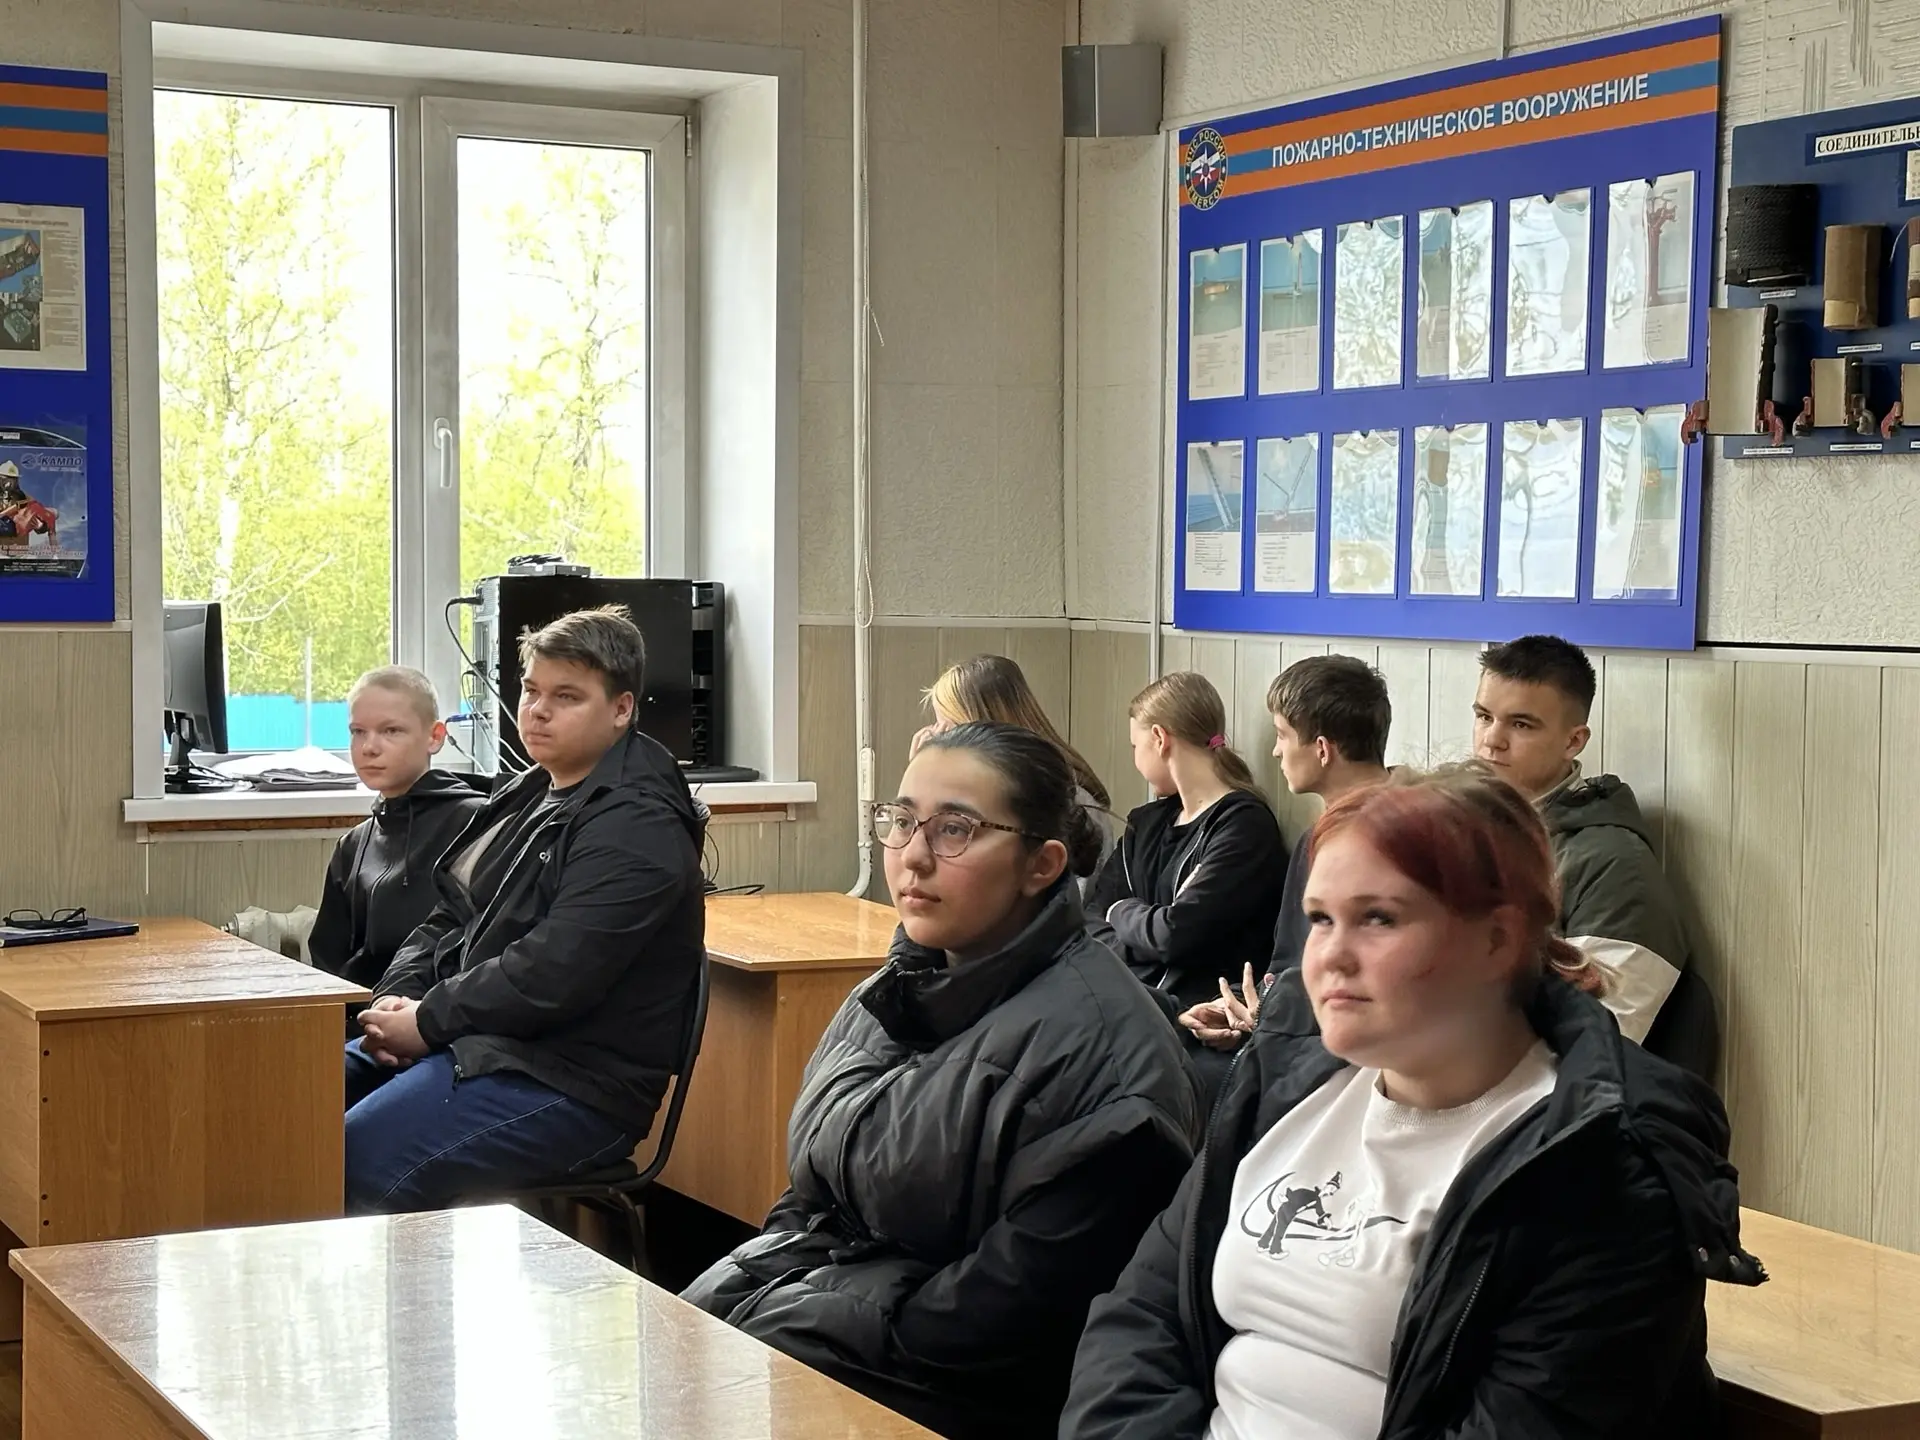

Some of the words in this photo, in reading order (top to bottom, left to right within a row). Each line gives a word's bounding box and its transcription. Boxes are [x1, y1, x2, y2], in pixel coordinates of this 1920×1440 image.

[1272, 104, 1495, 168] ПОЖАРНО-ТЕХНИЧЕСКОЕ
[1501, 73, 1649, 126] ВООРУЖЕНИЕ
[1186, 139, 1199, 166] МЧС
[1199, 130, 1226, 160] РОССИИ
[1187, 180, 1225, 208] EMERCOM
